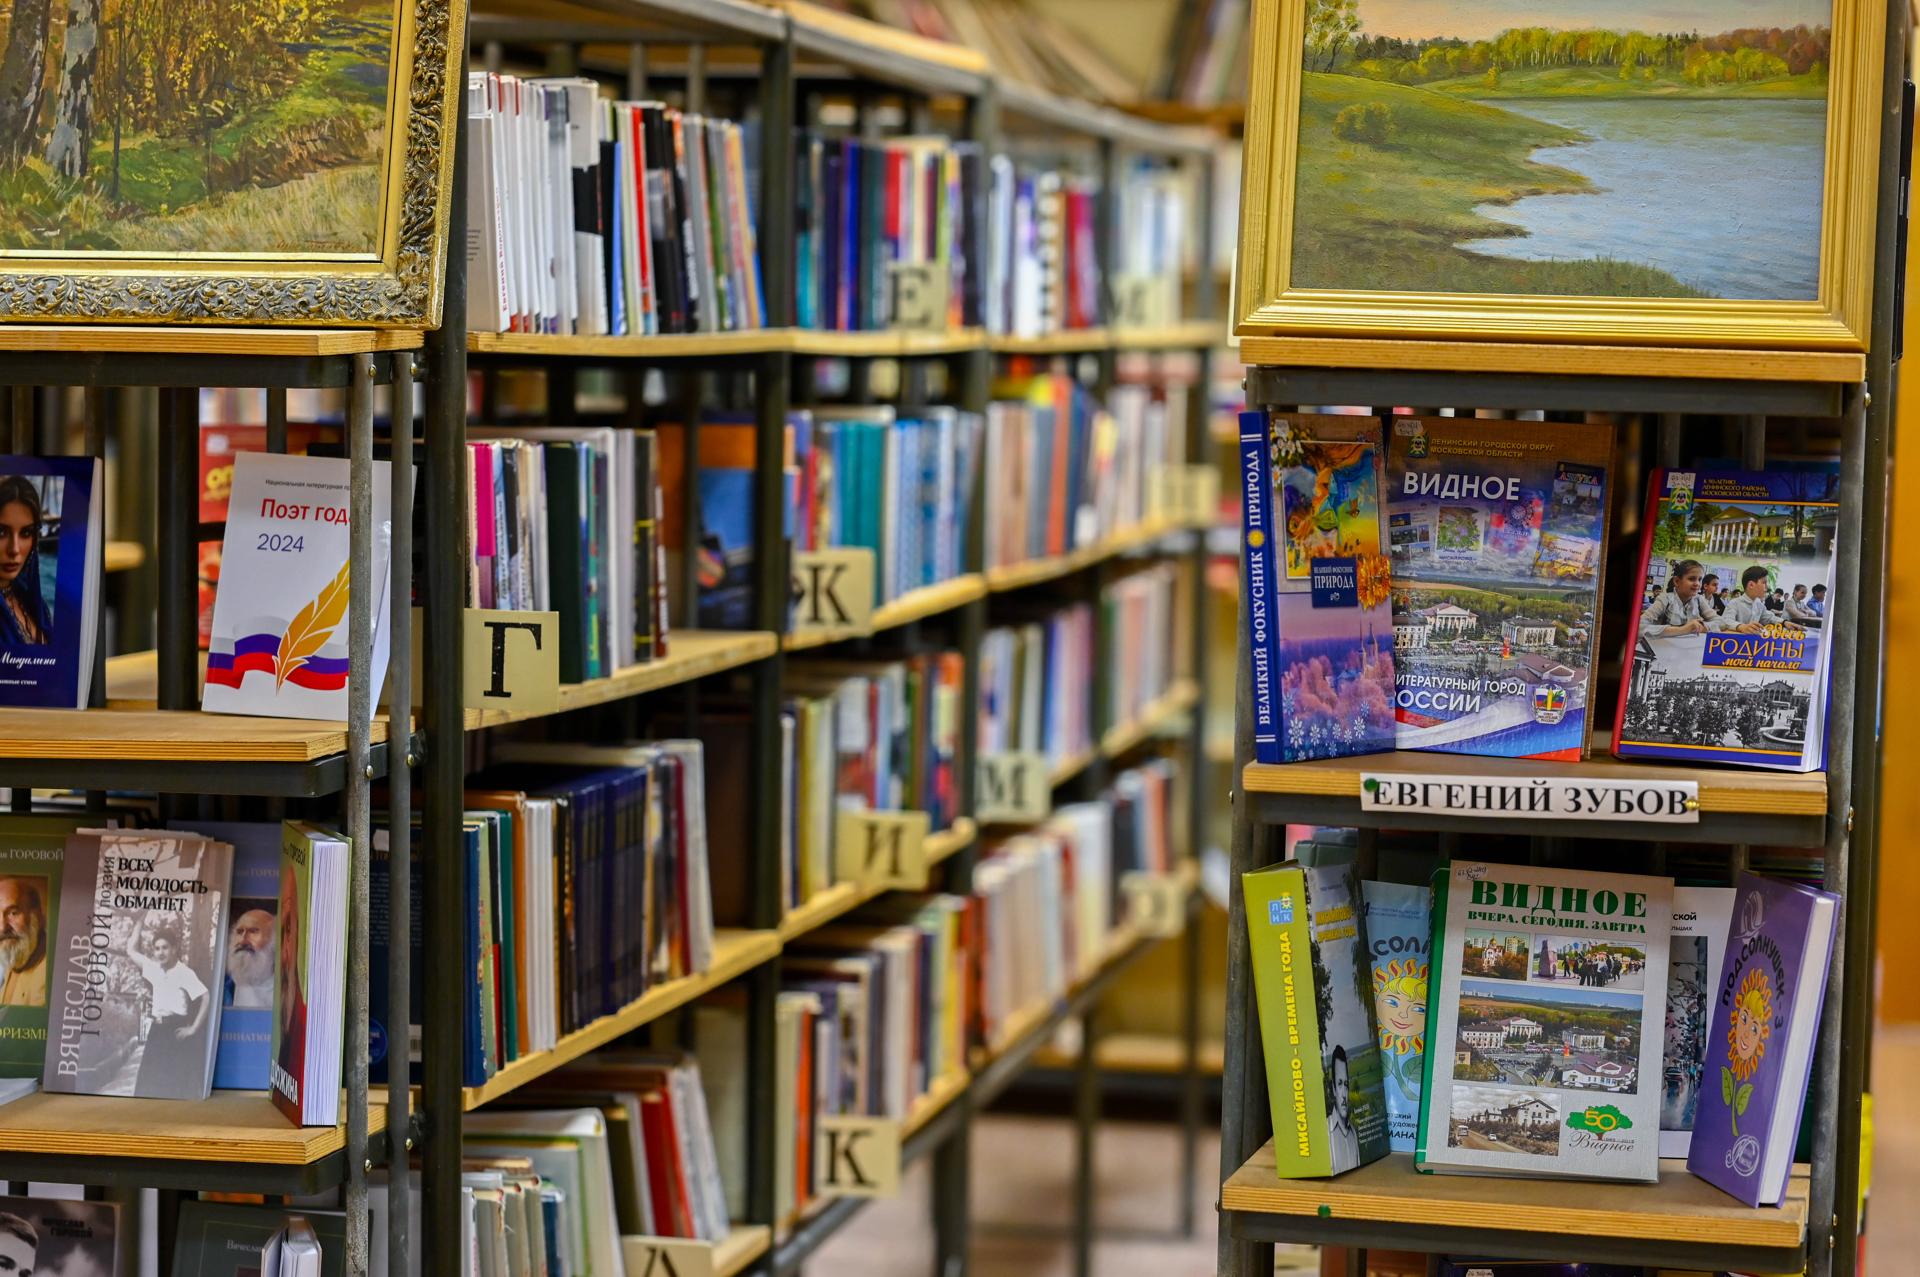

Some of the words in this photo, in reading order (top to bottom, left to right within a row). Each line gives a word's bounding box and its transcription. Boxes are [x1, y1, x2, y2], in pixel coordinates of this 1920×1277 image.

[1480, 440, 1527, 450] ГОРОДСКОЙ
[1246, 451, 1262, 527] ПРИРОДА
[1403, 471, 1521, 501] ВИДНОЕ
[261, 498, 310, 520] Поэт
[315, 506, 351, 526] год
[257, 533, 304, 552] 2024
[1314, 575, 1354, 590] ПРИРОДА
[1251, 553, 1267, 643] ФОКУСНИК
[1760, 623, 1806, 641] Здесь
[483, 621, 542, 698] Г
[1708, 637, 1804, 659] РОДИНЫ
[1722, 656, 1754, 668] моей
[1755, 659, 1801, 670] начало
[1254, 647, 1271, 725] ВЕЛИКИЙ
[1394, 673, 1481, 692] ИТЕРАТУРНЫЙ
[1484, 680, 1526, 697] ГОРОД
[1394, 689, 1481, 714] ОССИИ
[1372, 779, 1553, 813] ЕВГЕНИЙ
[1563, 786, 1689, 816] ЗУБОВ
[10, 848, 64, 861] ГОРОВОЙ
[863, 823, 906, 877] И
[117, 856, 156, 873] ВСЕХ
[115, 876, 208, 895] МОЛОДОСТЬ
[114, 895, 188, 912] ОБМАНЕТ
[1469, 880, 1647, 918] ВИДНОЕ
[1467, 910, 1519, 924] ВЧЕРА.
[1521, 915, 1589, 930] СЕГОДНЯ.
[1591, 920, 1646, 934] ЗАВТРА
[1671, 911, 1697, 921] СКОЙ
[1279, 931, 1292, 973] ГОДА
[58, 935, 92, 1077] ВЯЧЕСЛАВ
[81, 913, 113, 1037] ГОРОВОЙ
[1283, 975, 1299, 1045] ВРЕМЕНА
[1291, 1058, 1310, 1158] МИСАЙЛОВО
[1584, 1111, 1617, 1131] 50
[1569, 1131, 1634, 1157] Видное
[821, 1129, 879, 1187] К
